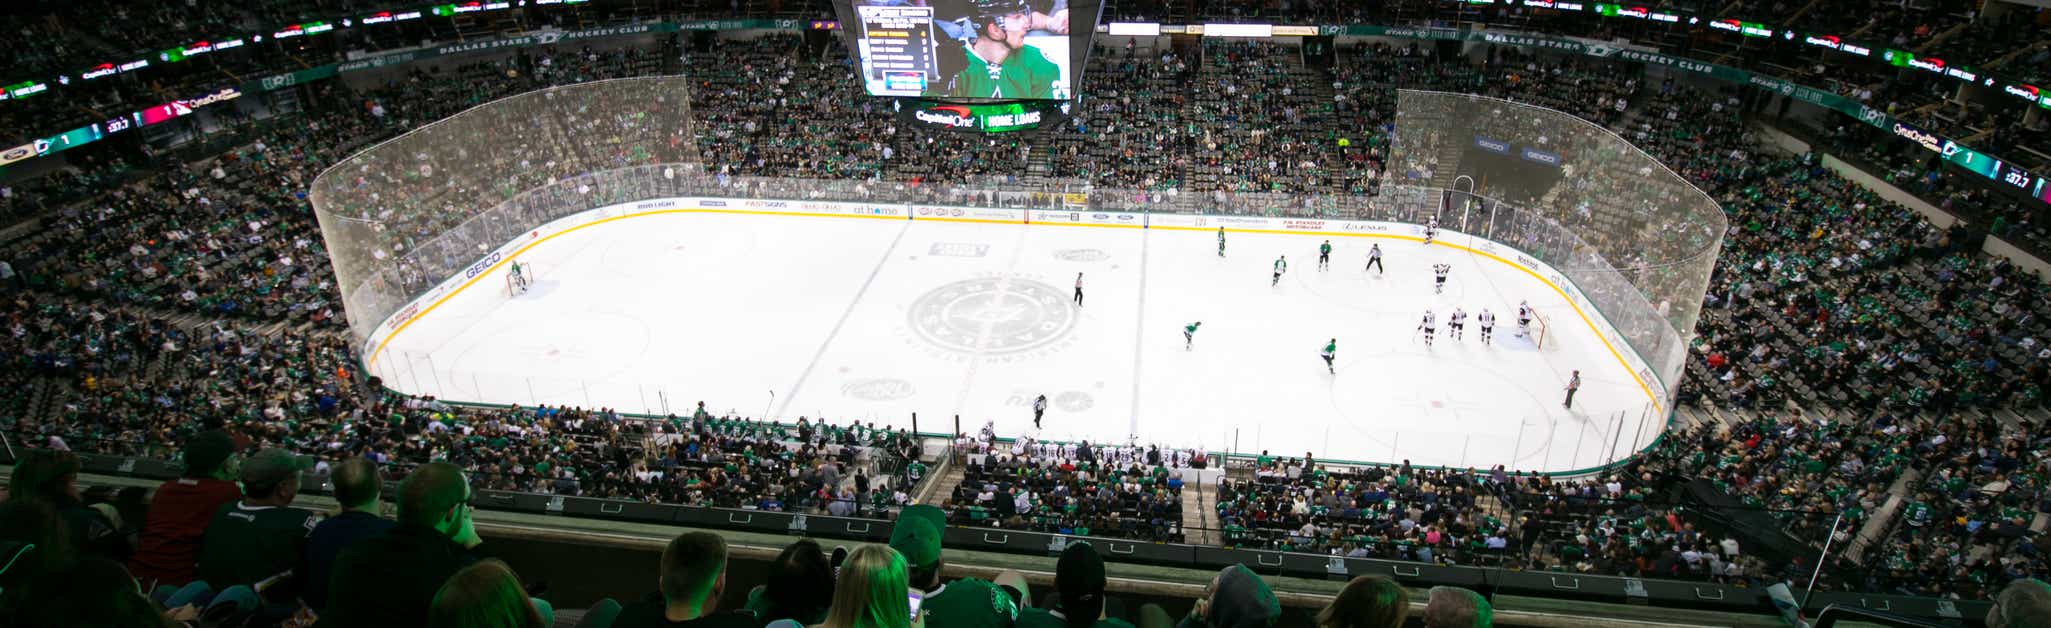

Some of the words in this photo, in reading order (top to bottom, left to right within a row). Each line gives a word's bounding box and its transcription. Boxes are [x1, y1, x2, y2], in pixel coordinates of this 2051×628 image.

[569, 28, 614, 38] HOCKEY
[620, 25, 648, 34] CLUB
[440, 41, 488, 54] DALLAS
[492, 37, 530, 48] STARS
[1485, 33, 1533, 46] DALLAS
[1539, 38, 1580, 49] STARS
[1622, 51, 1674, 65] HOCKEY
[1679, 60, 1713, 73] CLUB
[988, 116, 1013, 127] HOME
[1015, 111, 1040, 125] LOANS
[466, 252, 501, 280] GEICO
